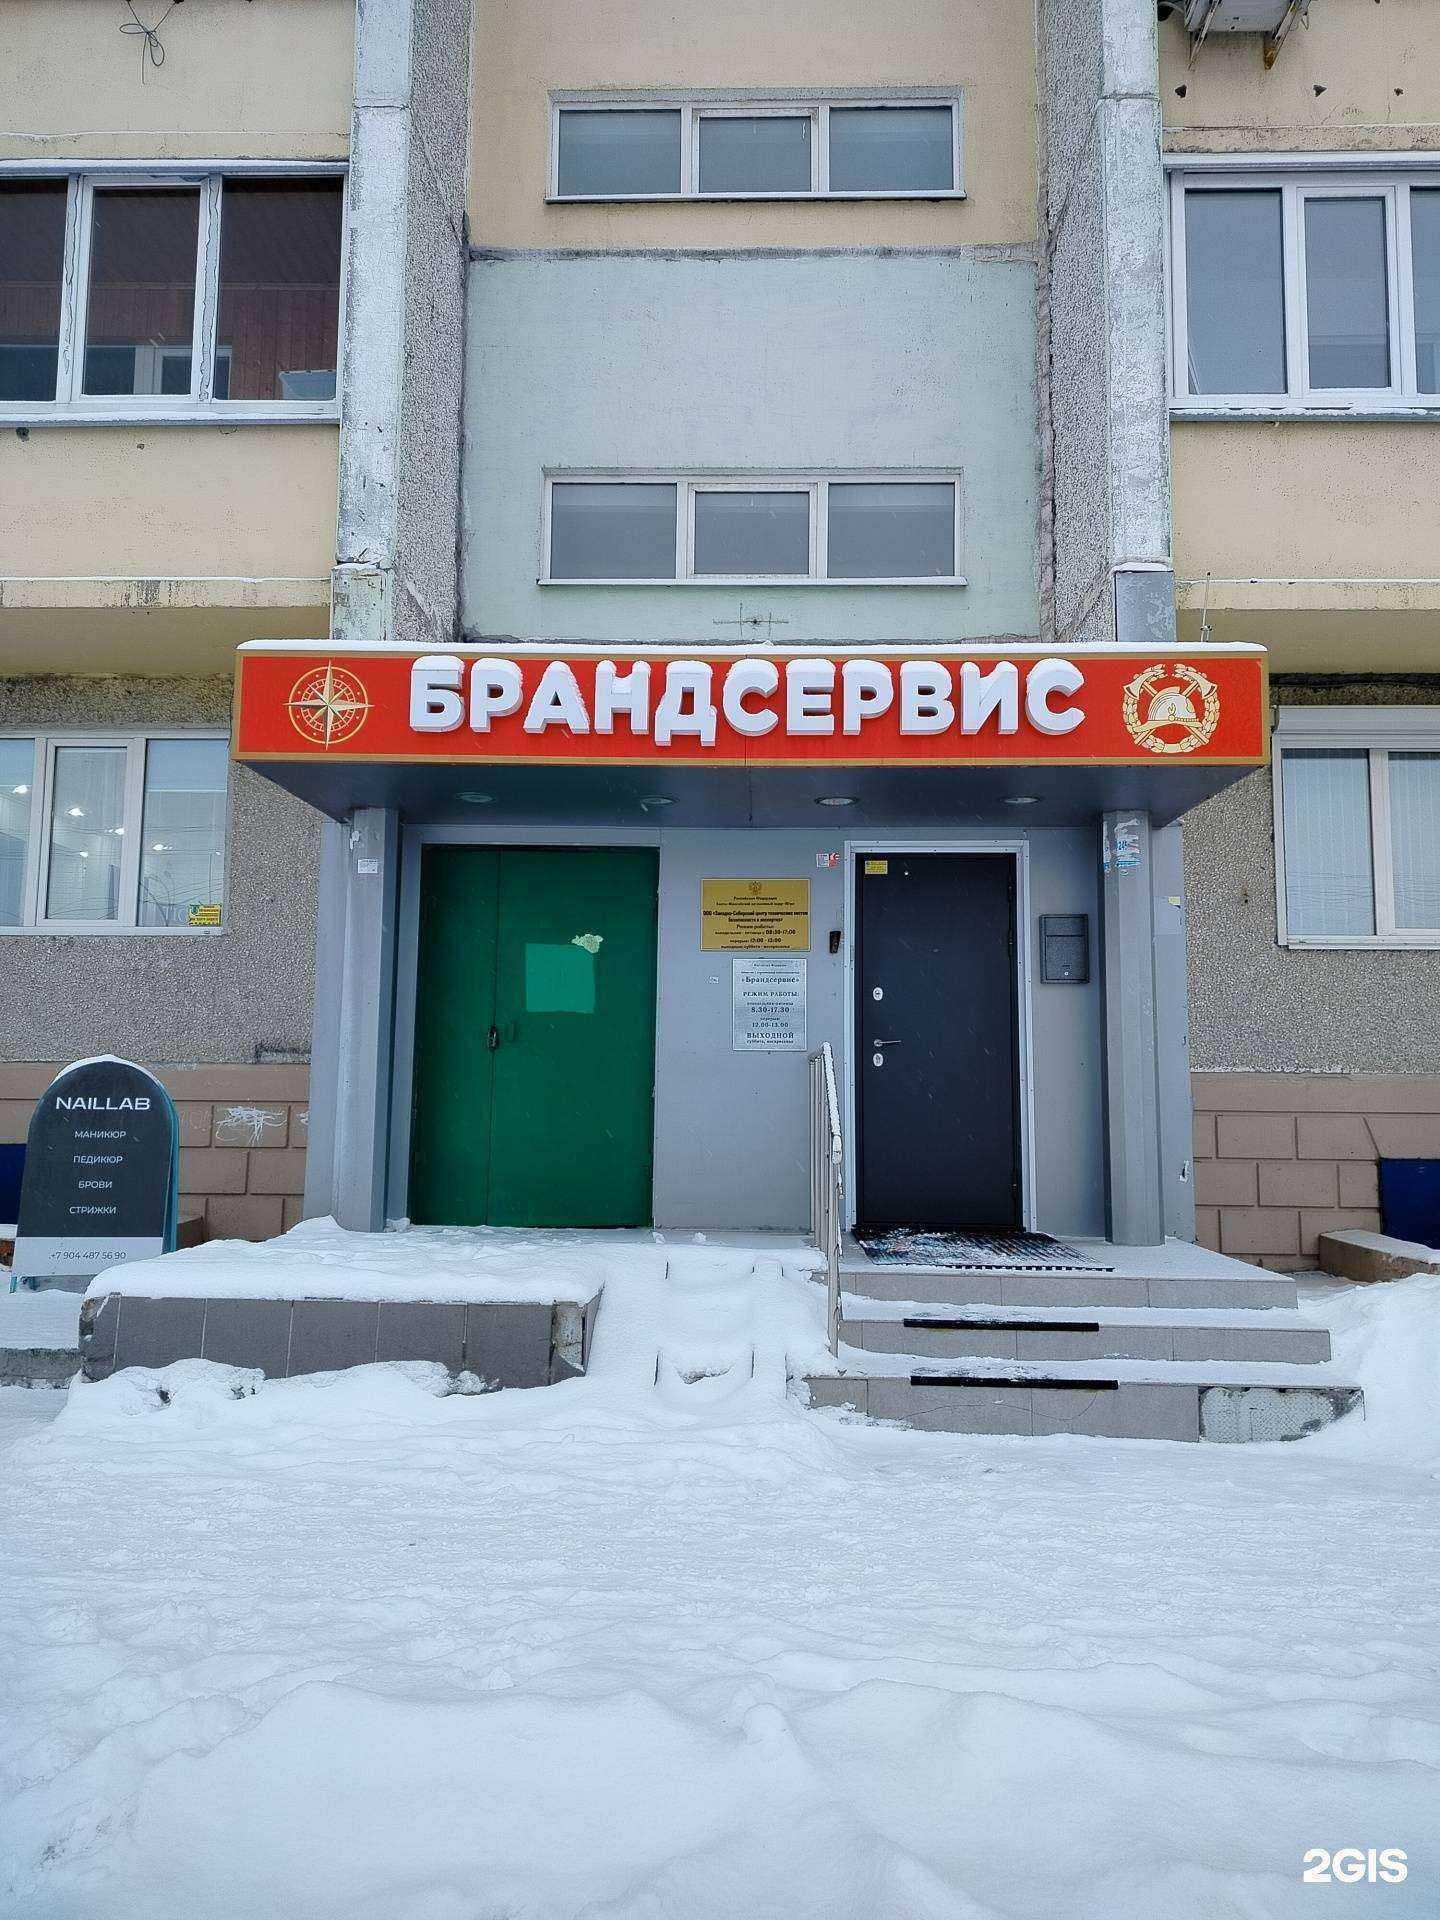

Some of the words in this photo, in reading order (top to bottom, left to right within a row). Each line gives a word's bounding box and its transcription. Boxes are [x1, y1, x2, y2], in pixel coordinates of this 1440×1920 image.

[408, 655, 1087, 747] БРАНДСЕРВИС
[747, 1031, 794, 1039] ВЫХОДНОЙ
[55, 1096, 151, 1111] NAILLAB
[74, 1130, 127, 1140] МАНИКЮР
[73, 1155, 123, 1165] ПЕДИКЮР
[78, 1180, 113, 1189] БРОВИ
[69, 1205, 117, 1215] СТРИЖКИ
[51, 1251, 61, 1259] +7
[63, 1251, 81, 1260] 904
[82, 1251, 101, 1260] 487
[102, 1251, 113, 1260] 56
[113, 1251, 126, 1260] 90
